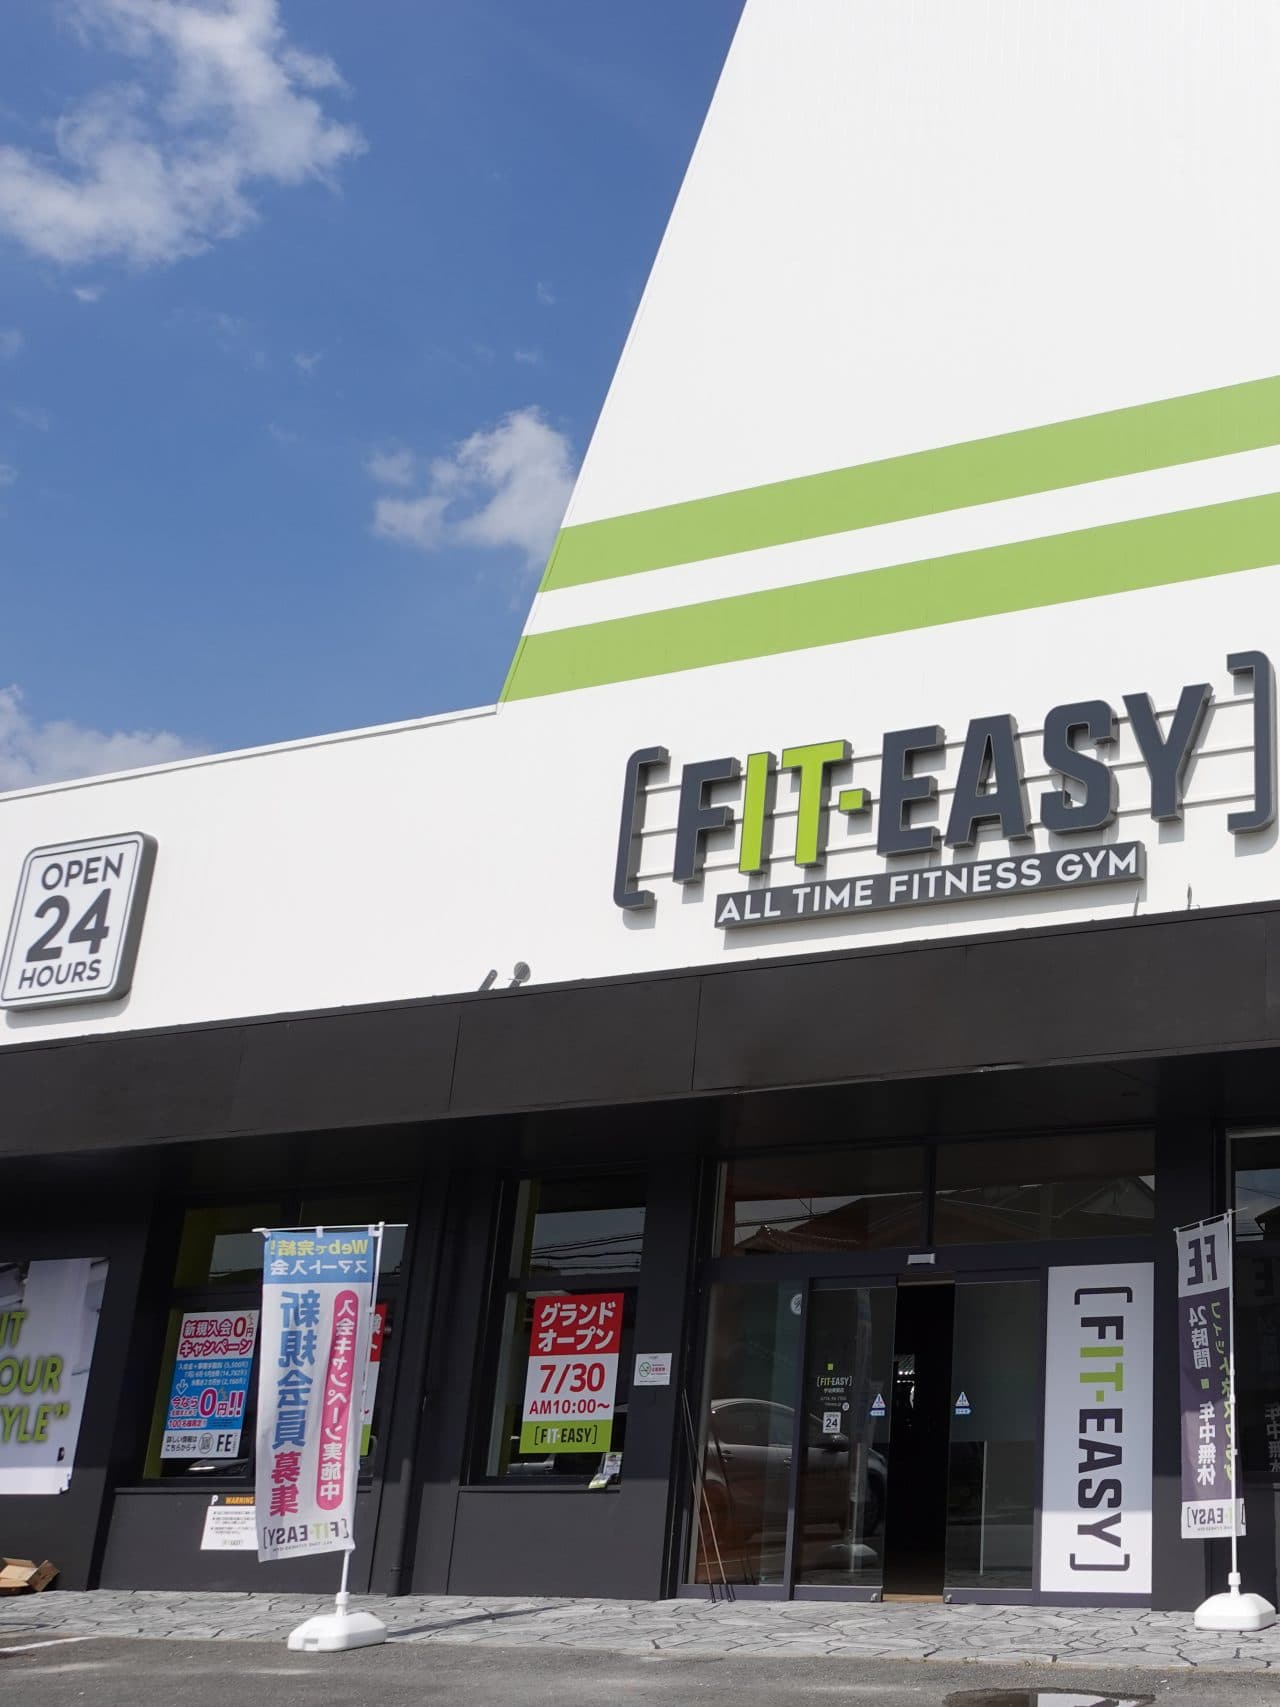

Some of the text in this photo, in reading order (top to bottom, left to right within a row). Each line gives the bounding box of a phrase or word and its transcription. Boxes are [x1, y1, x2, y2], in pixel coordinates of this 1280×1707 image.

[41, 852, 124, 891] OPEN
[717, 845, 1137, 924] ALL TIME FITNESS GYM
[25, 888, 112, 963] 24
[18, 958, 101, 990] HOURS
[540, 1301, 616, 1328] グランド
[179, 1337, 254, 1358] キャンペーン
[537, 1325, 614, 1352] オープン
[539, 1362, 606, 1395] 7/30
[825, 1418, 838, 1428] 24
